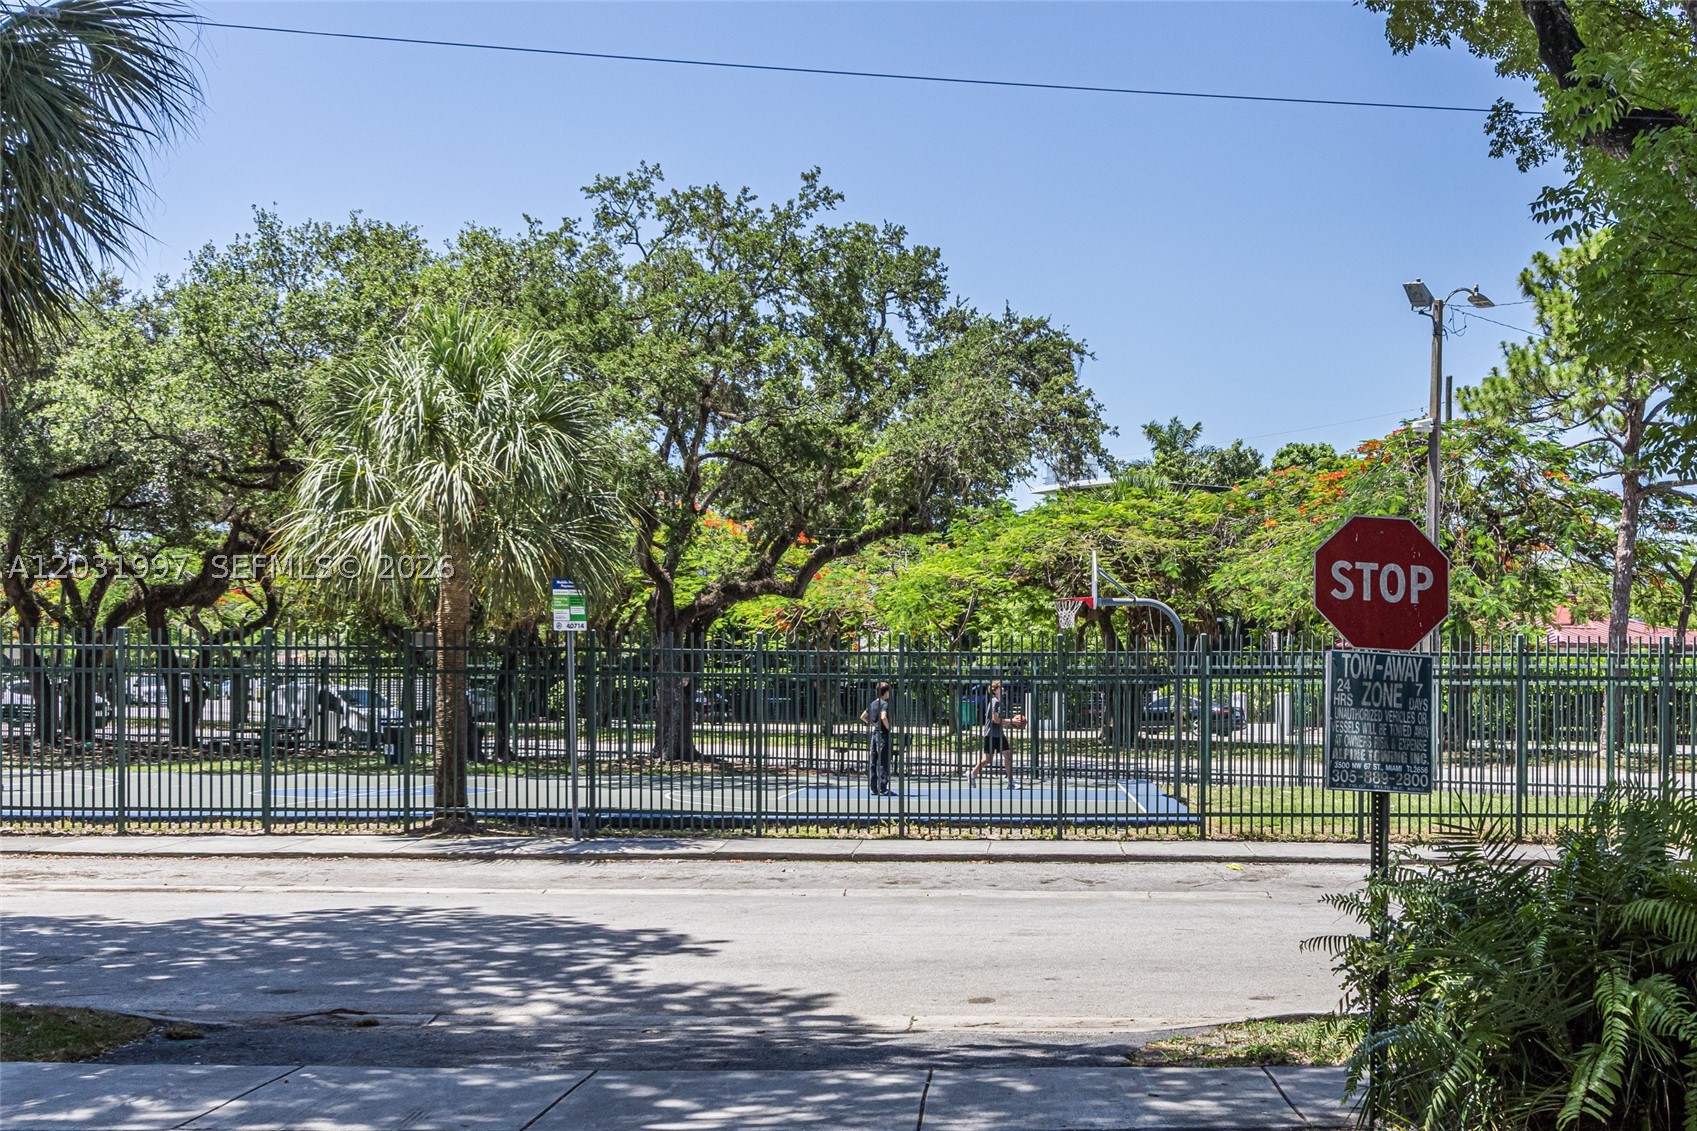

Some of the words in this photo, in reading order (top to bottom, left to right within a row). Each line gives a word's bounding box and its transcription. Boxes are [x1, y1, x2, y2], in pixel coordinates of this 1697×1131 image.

[1330, 560, 1434, 604] STOP
[1341, 653, 1423, 682] TOW-AWAY
[1337, 678, 1351, 692] 24
[1415, 683, 1423, 696] 7
[1333, 693, 1353, 706] HRS
[1361, 681, 1403, 708] ZONE
[1408, 697, 1428, 711] DAYS
[1334, 707, 1383, 722] UNAUTHORIZED
[1384, 710, 1415, 724] VEHICLES
[1417, 712, 1427, 725] OR
[1332, 720, 1360, 734] VESSELS
[1361, 722, 1376, 735] WILL
[1378, 723, 1387, 735] BE
[1389, 724, 1412, 737] TOWED
[1413, 725, 1430, 738] AWAY
[1334, 734, 1342, 746] AT
[1374, 737, 1389, 749] RISK
[1398, 738, 1427, 752] EXPENSE
[1332, 748, 1366, 761] ALPINE
[1368, 750, 1408, 763] TOWING
[1351, 762, 1363, 770] NW
[1385, 764, 1403, 772] MIAMI
[1332, 769, 1428, 787] 305-889-2800
